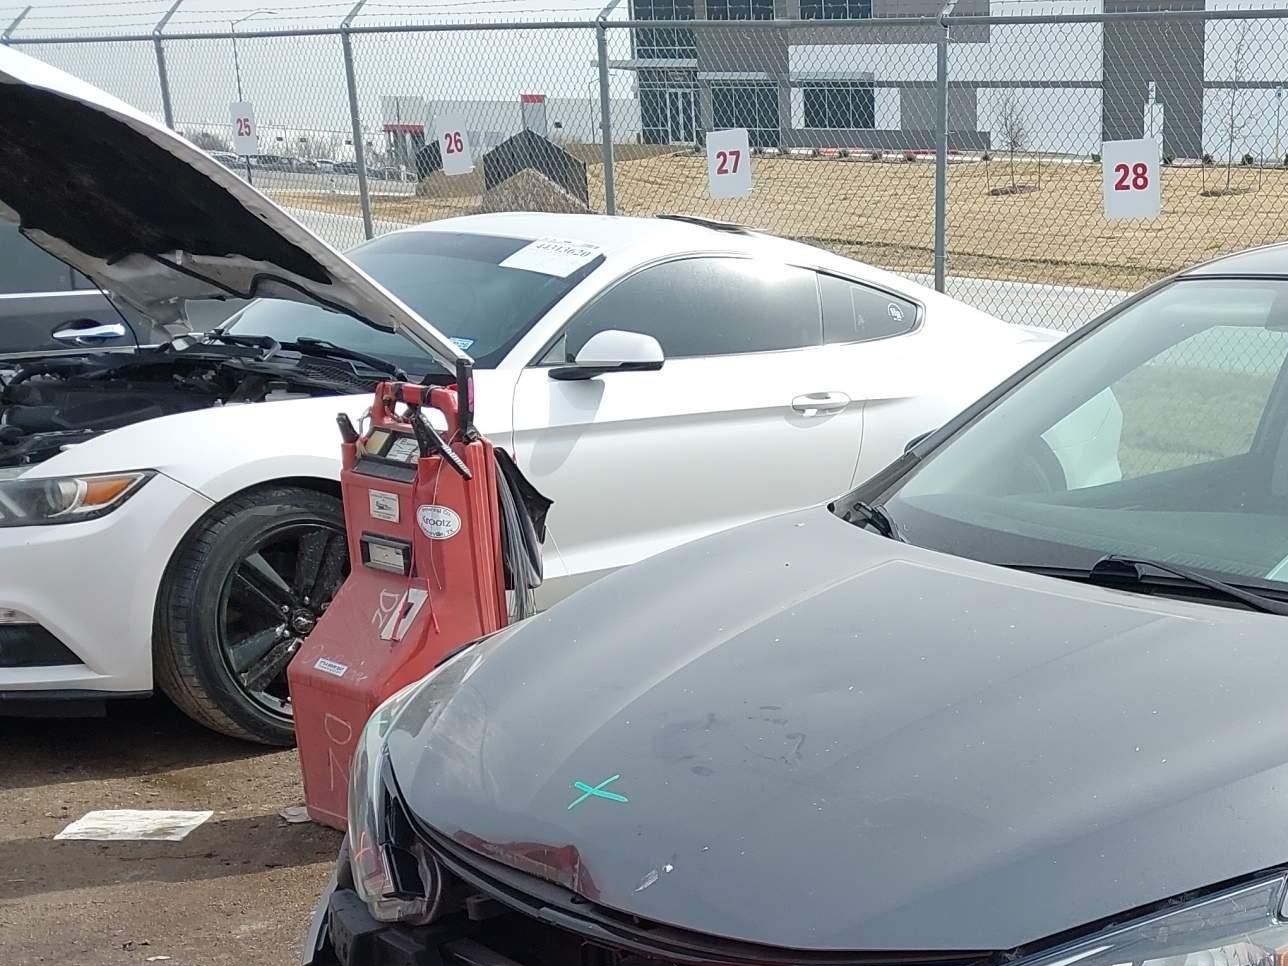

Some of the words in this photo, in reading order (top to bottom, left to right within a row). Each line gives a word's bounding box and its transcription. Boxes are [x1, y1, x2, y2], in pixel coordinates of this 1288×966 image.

[236, 117, 251, 137] 25
[444, 131, 464, 154] 26
[716, 150, 741, 175] 27
[1113, 162, 1150, 193] 28
